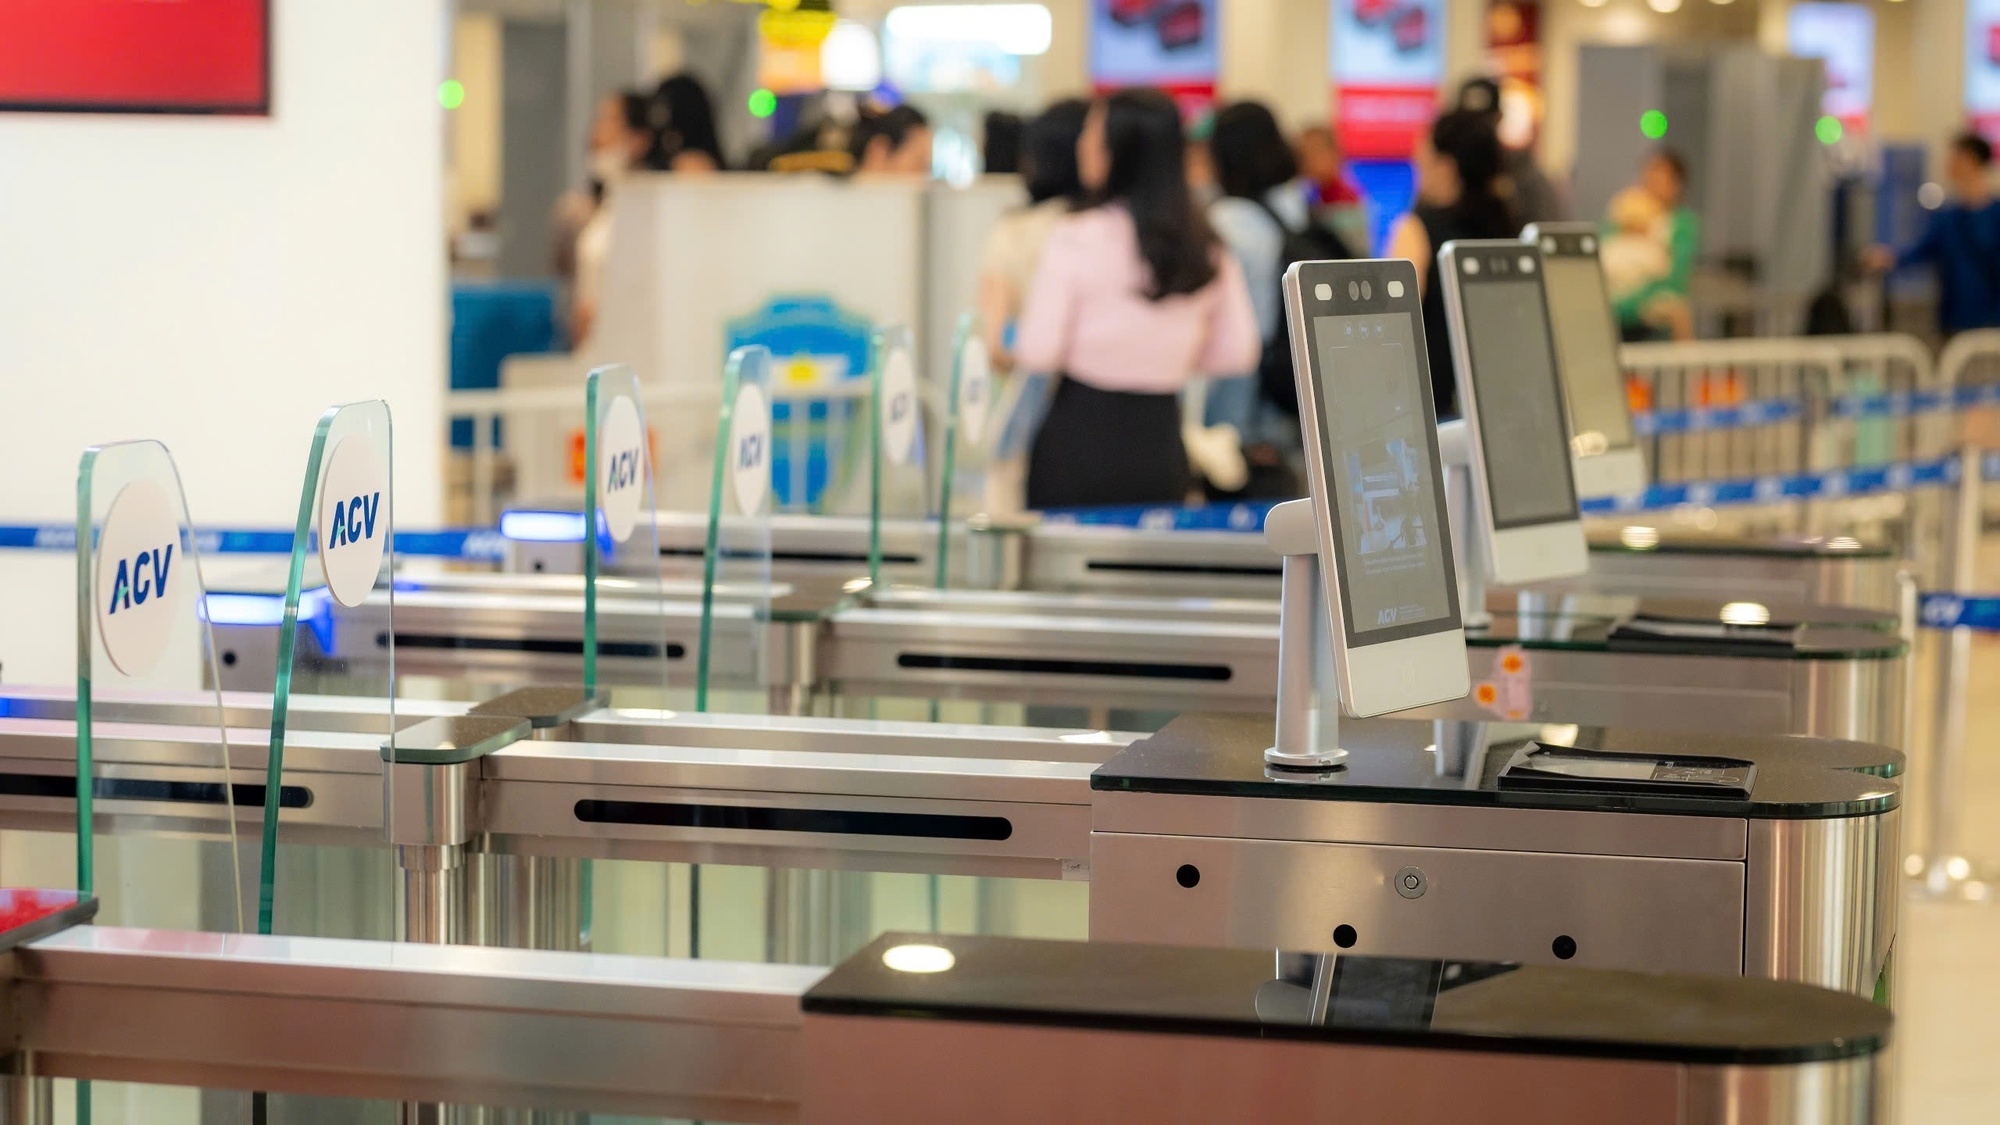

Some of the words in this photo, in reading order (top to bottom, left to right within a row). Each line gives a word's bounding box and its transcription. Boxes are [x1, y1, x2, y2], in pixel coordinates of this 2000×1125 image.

[607, 448, 639, 493] ACV
[329, 491, 380, 549] ACV
[109, 544, 173, 614] ACV
[1377, 608, 1397, 625] ACV
